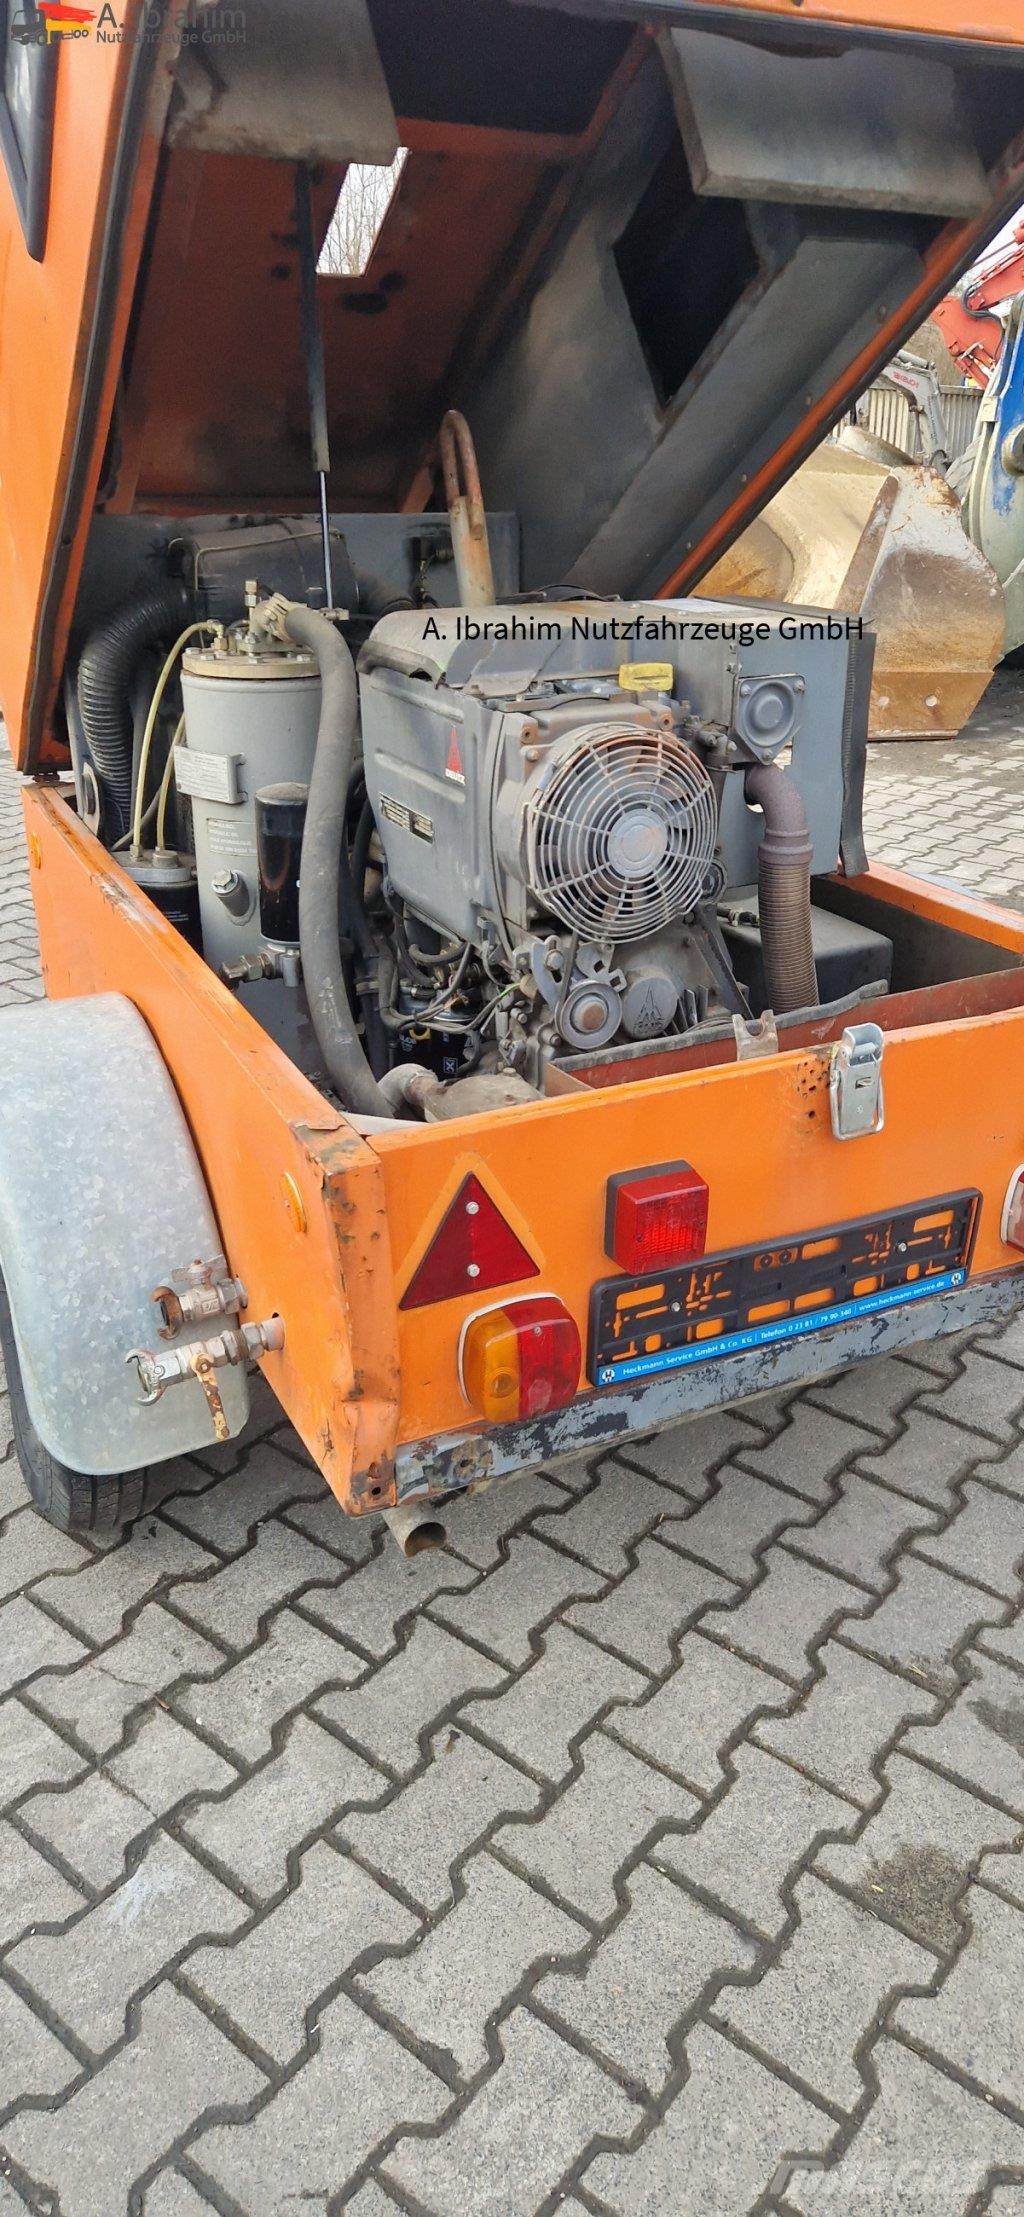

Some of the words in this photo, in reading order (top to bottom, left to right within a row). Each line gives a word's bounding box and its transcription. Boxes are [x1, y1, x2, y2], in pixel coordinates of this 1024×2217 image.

[623, 1360, 664, 1375] Heckmann
[666, 1352, 693, 1364] Service
[694, 1345, 718, 1356] GmbH
[742, 1335, 752, 1343] KG
[761, 1328, 787, 1339] Telefon
